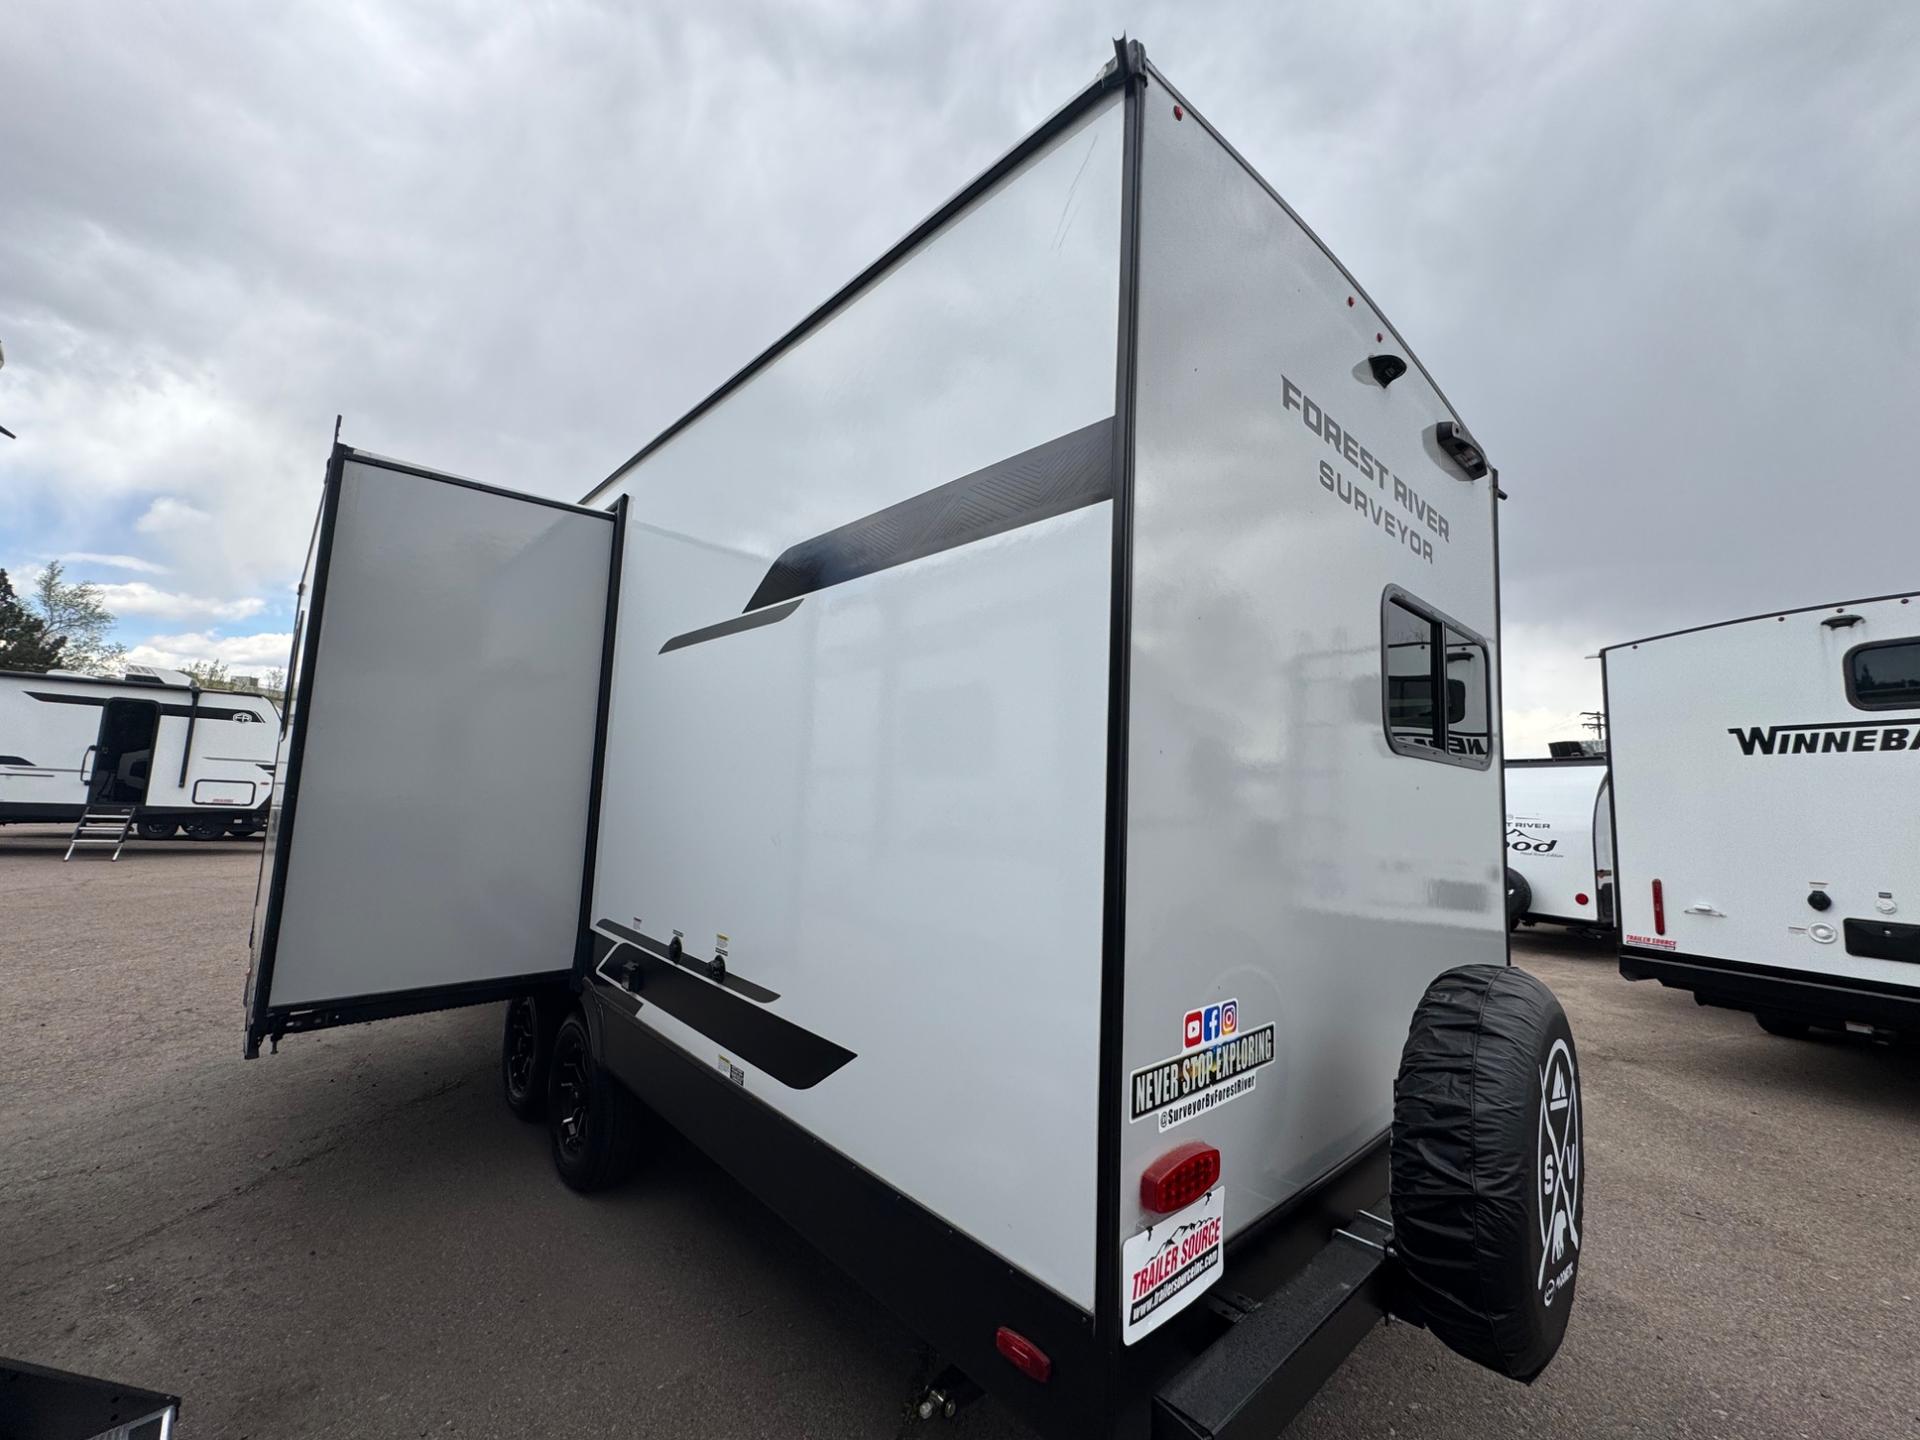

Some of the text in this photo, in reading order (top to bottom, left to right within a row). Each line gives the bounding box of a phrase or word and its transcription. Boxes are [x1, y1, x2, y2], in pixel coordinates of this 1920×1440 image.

[1281, 374, 1450, 543] FOREST RIVER
[1319, 459, 1433, 564] SURVEYOR
[1506, 839, 1558, 853] od
[1135, 1028, 1273, 1114] NEVER STOP EXPLORING
[1160, 1075, 1255, 1128] @SurveyorByForestRiver
[1132, 1216, 1221, 1301] TRAILER SOURCE
